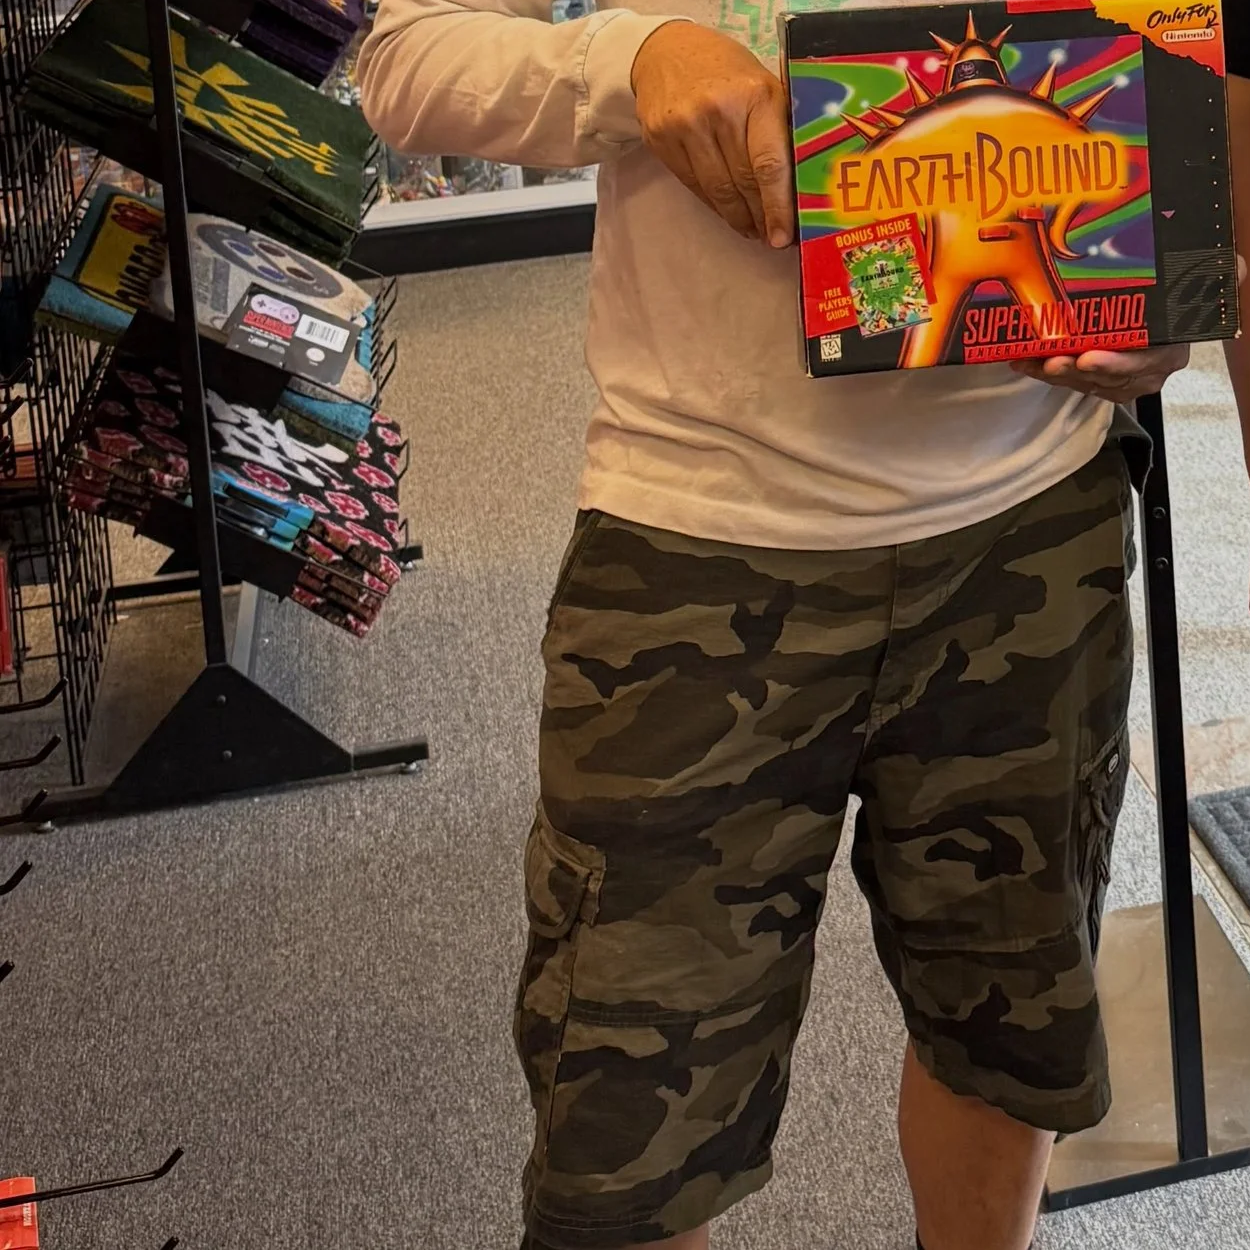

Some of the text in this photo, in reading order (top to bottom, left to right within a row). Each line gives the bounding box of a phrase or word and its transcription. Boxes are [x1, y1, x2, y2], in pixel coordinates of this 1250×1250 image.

[1146, 6, 1186, 29] Only
[835, 218, 912, 249] BONUS INSIDE
[823, 286, 842, 298] FREE
[826, 307, 850, 322] GUIDE
[962, 293, 1146, 346] SUPER NINTENDO
[967, 331, 1148, 359] ENTERTAINMENT SYSTEM
